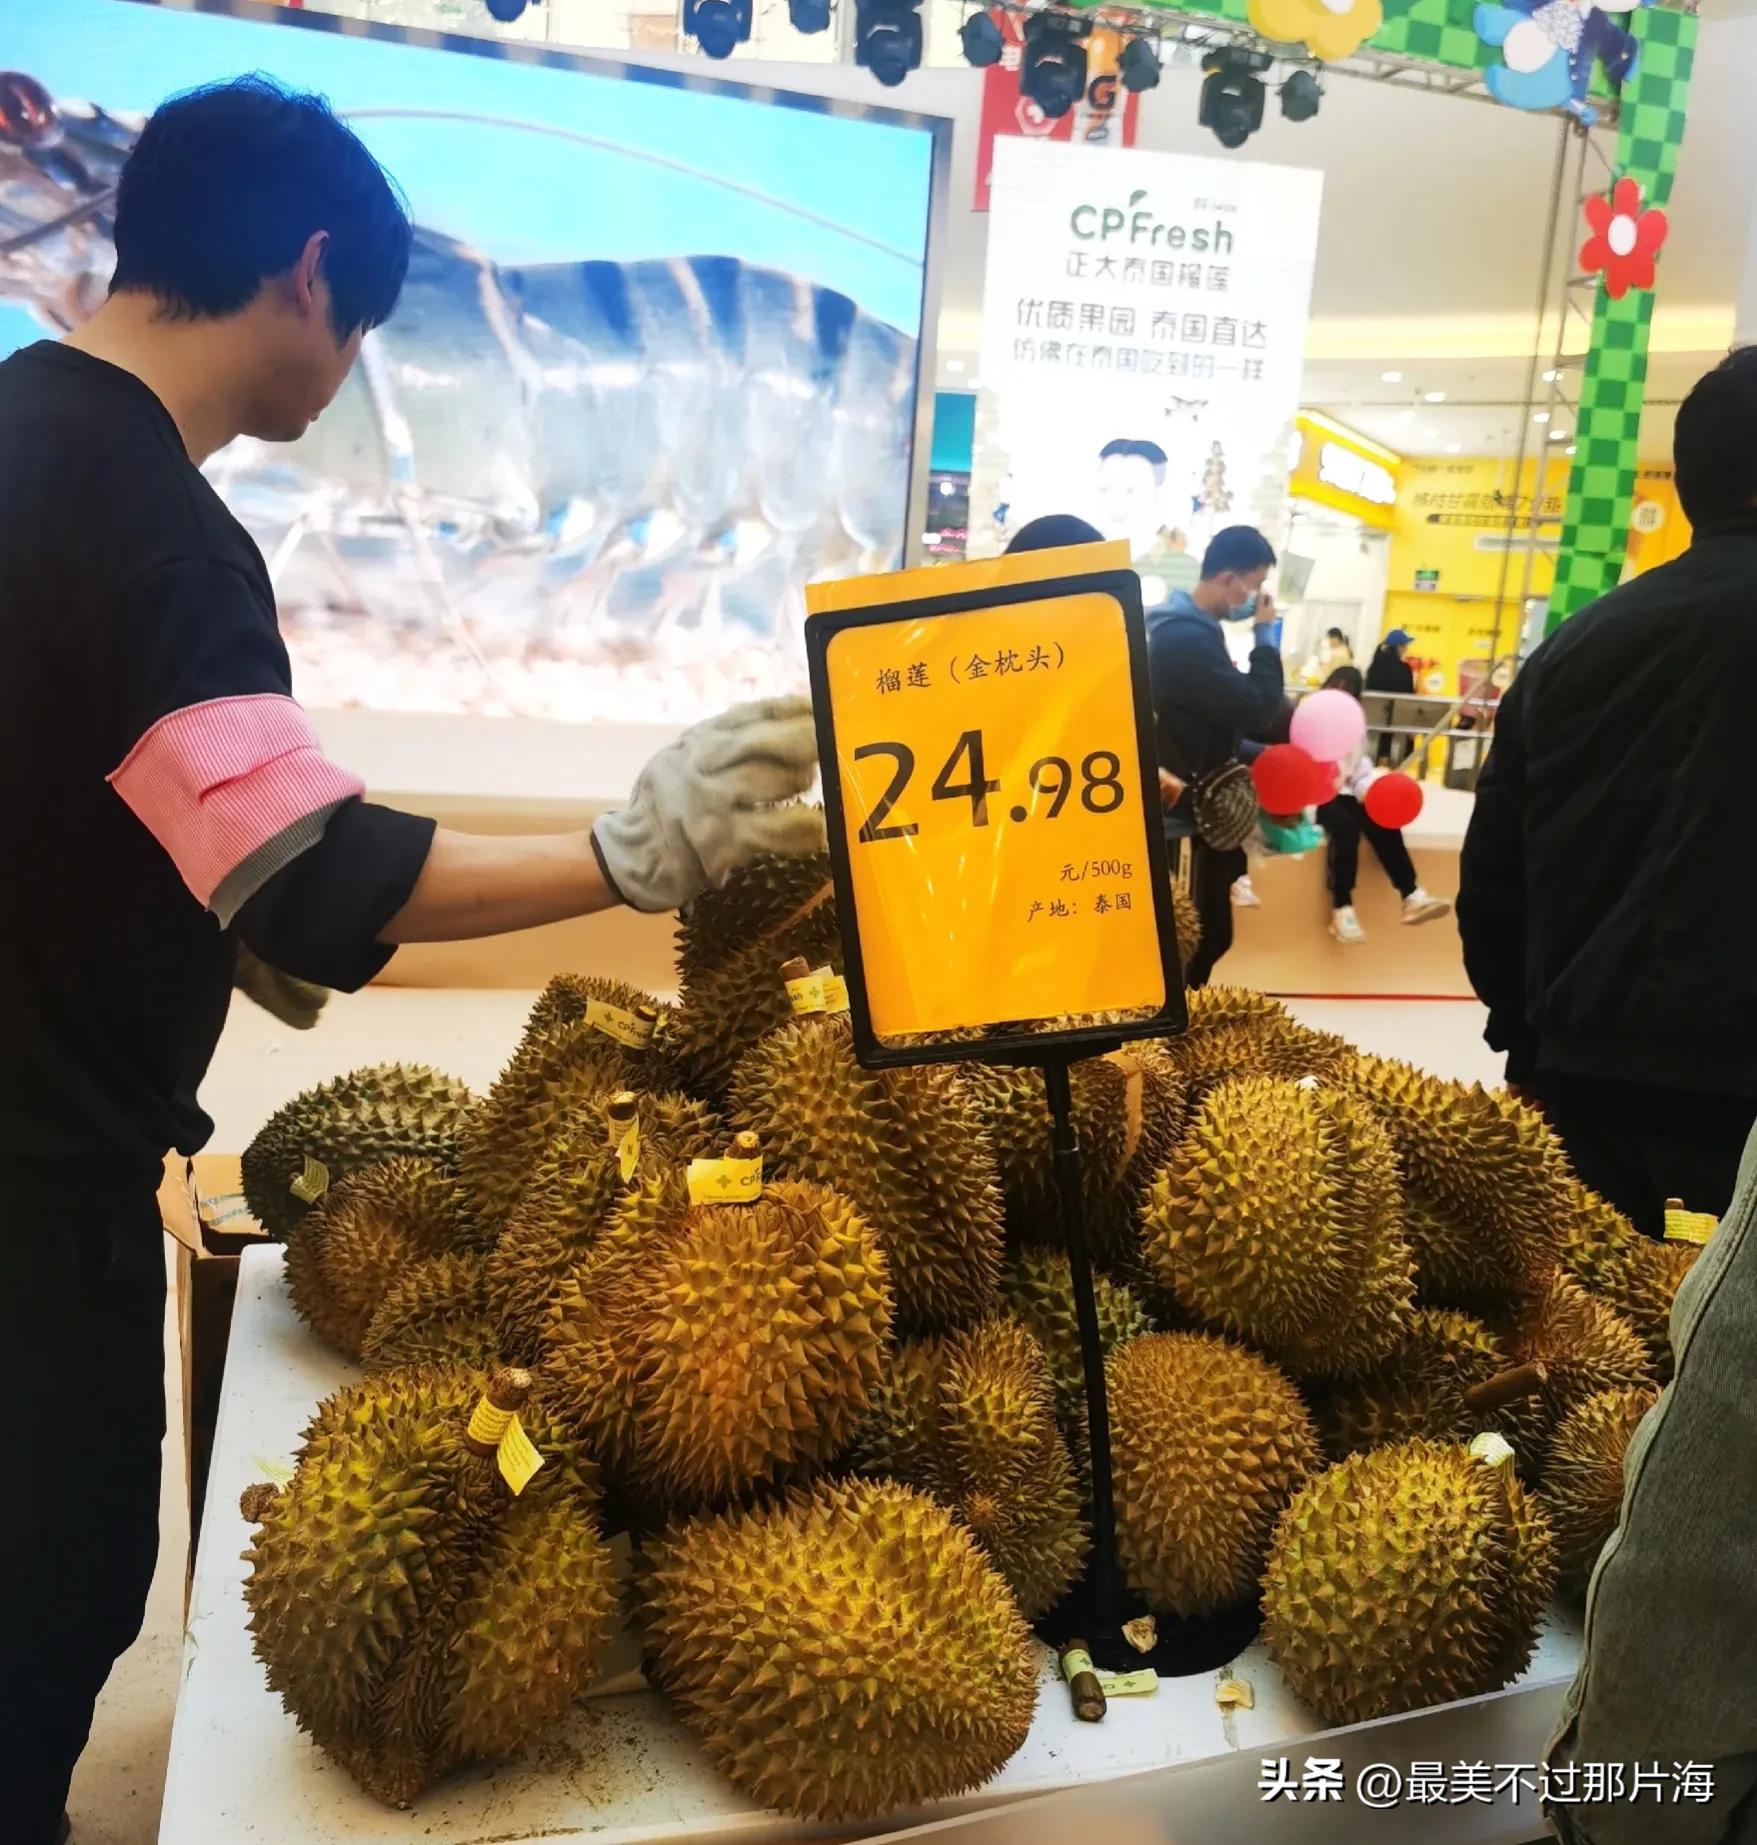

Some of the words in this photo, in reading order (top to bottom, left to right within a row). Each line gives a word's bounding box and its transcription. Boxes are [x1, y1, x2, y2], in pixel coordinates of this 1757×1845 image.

[1069, 204, 1234, 255] CPFresh
[1066, 250, 1230, 292] 正大泰国榴莲
[1016, 297, 1136, 337] 优质果园
[1150, 310, 1268, 349] 泰国直达
[1013, 337, 1265, 381] 仿佛在泰国吃到的一样
[853, 729, 1126, 844] 24.98
[1059, 858, 1133, 883] 元/500g
